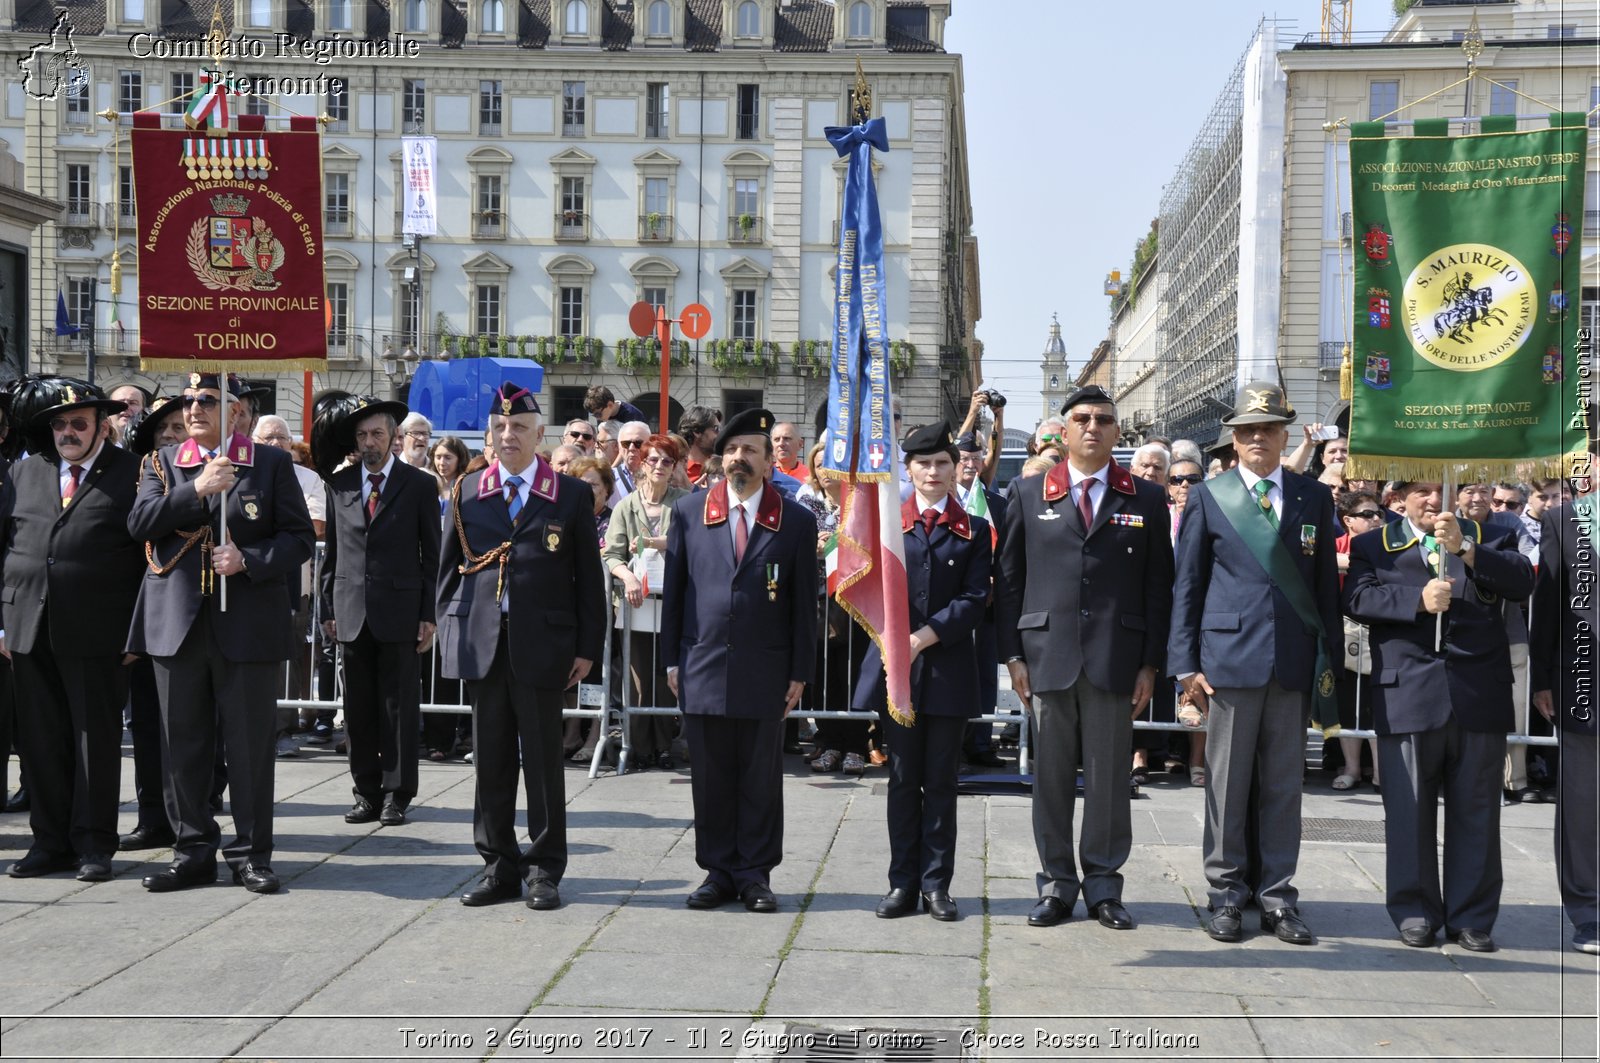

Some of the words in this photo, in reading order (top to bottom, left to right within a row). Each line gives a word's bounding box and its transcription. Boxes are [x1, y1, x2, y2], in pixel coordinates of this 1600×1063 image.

[1359, 162, 1432, 174] ASSOCIAZIONE
[1434, 159, 1495, 173] NAZIONALE
[1496, 155, 1542, 170] NASTRO
[1543, 152, 1580, 165] VERDE
[1372, 181, 1416, 192] Decorati
[1422, 180, 1470, 193] Medaglia
[1472, 178, 1502, 189] d'Oro
[1505, 174, 1568, 187] Mauriziana
[144, 187, 194, 253] Associazione
[194, 179, 256, 192] Nazionale
[257, 185, 293, 213] Polizia
[291, 211, 305, 227] di
[299, 223, 316, 256] Stato
[838, 229, 857, 270] Italiana
[1417, 276, 1433, 289] S.
[1430, 252, 1518, 283] MAURIZIO
[838, 273, 853, 303] Rossa
[859, 264, 881, 339] METROPOLI
[147, 295, 213, 310] SEZIONE
[220, 296, 319, 311] PROVINCIALE
[229, 317, 241, 328] di
[688, 313, 703, 335] T
[838, 304, 850, 333] Croce
[1408, 299, 1448, 360] PROTETTORE
[1449, 353, 1489, 365] DELLE
[1488, 322, 1526, 359] NOSTRE
[1519, 291, 1531, 323] ARMI
[194, 333, 277, 350] TORINO
[837, 335, 849, 373] Militari
[868, 341, 885, 381] TORINO
[871, 383, 884, 394] DI
[870, 396, 884, 439] SEZIONE
[1404, 405, 1463, 417] SEZIONE
[1466, 401, 1532, 415] PIEMONTE
[1473, 417, 1512, 429] MAURO
[1512, 417, 1539, 426] GIGLI
